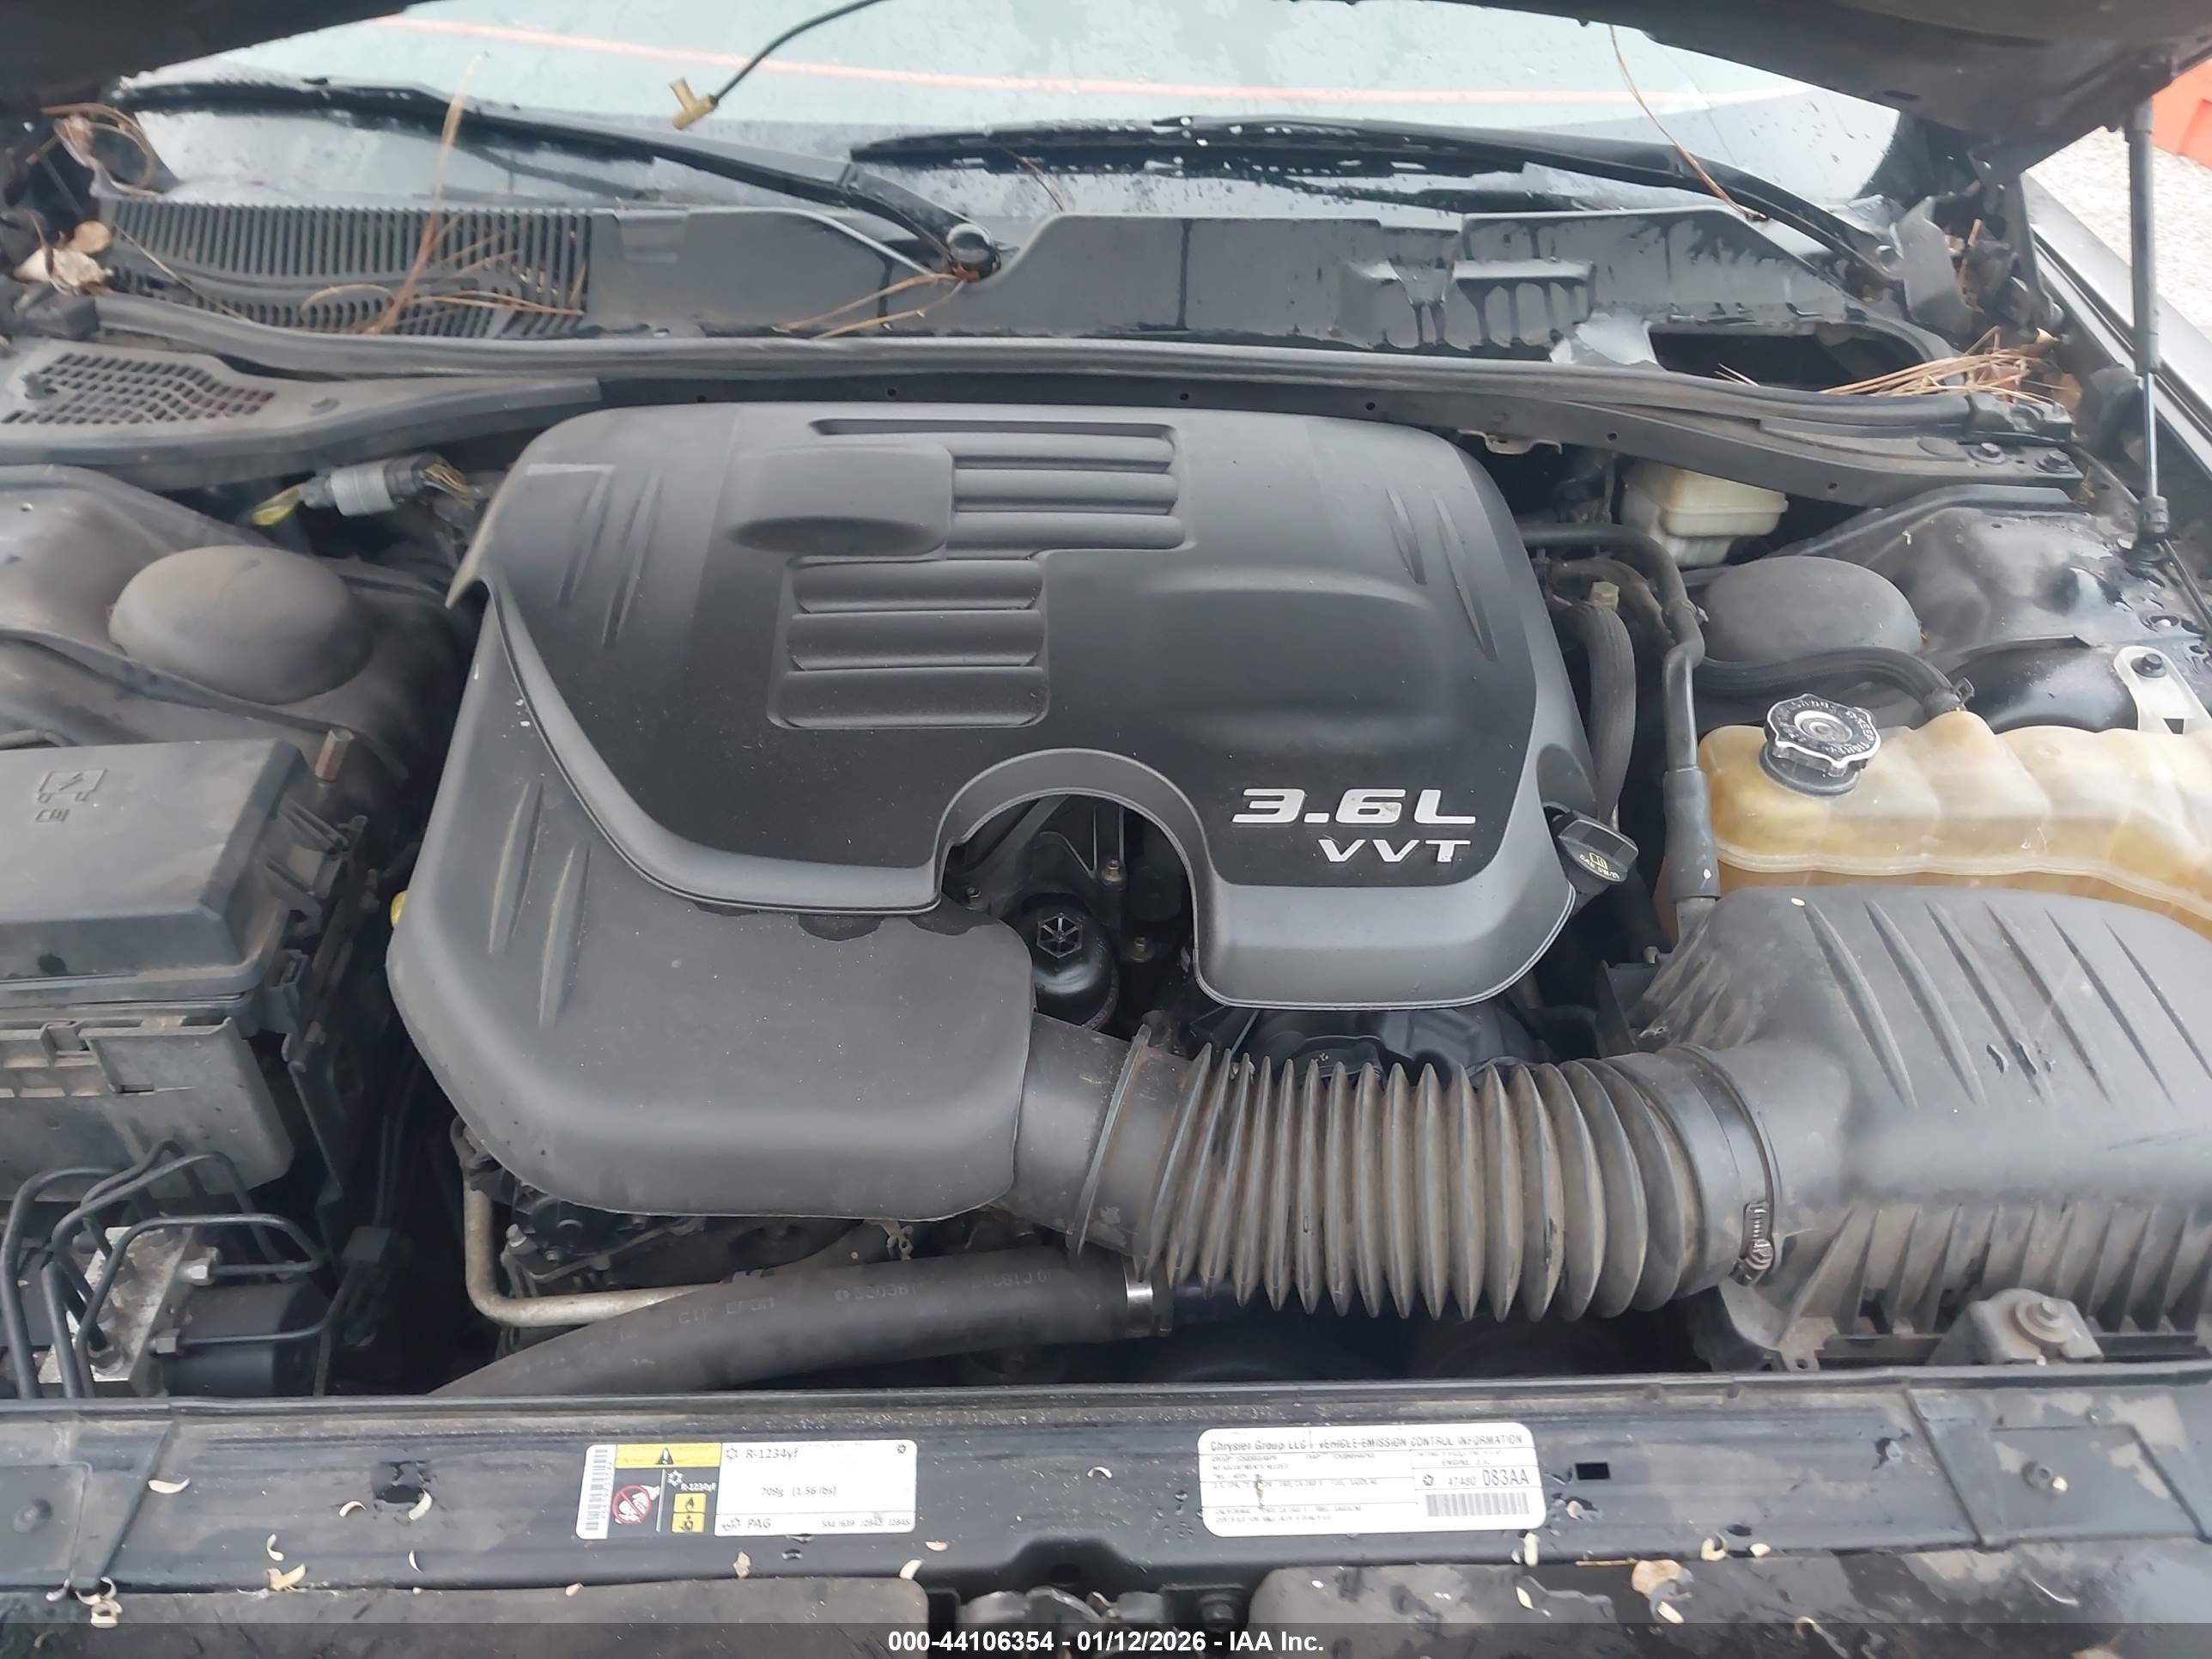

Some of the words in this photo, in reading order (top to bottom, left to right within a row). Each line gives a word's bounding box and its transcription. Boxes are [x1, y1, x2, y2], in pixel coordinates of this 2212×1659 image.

[1856, 718, 1875, 742] KEEP
[1231, 787, 1477, 824] 3.6L
[1317, 838, 1472, 862] VVT
[1210, 1440, 1251, 1451] Chrysler
[1255, 1439, 1285, 1450] Group
[1287, 1439, 1306, 1449] LLC
[1409, 1435, 1455, 1446] CONTROL
[1458, 1434, 1523, 1446] INFORMATION
[744, 1447, 800, 1461] R-1234yf
[1482, 1468, 1530, 1486] 083AA
[746, 1517, 772, 1529] PAG
